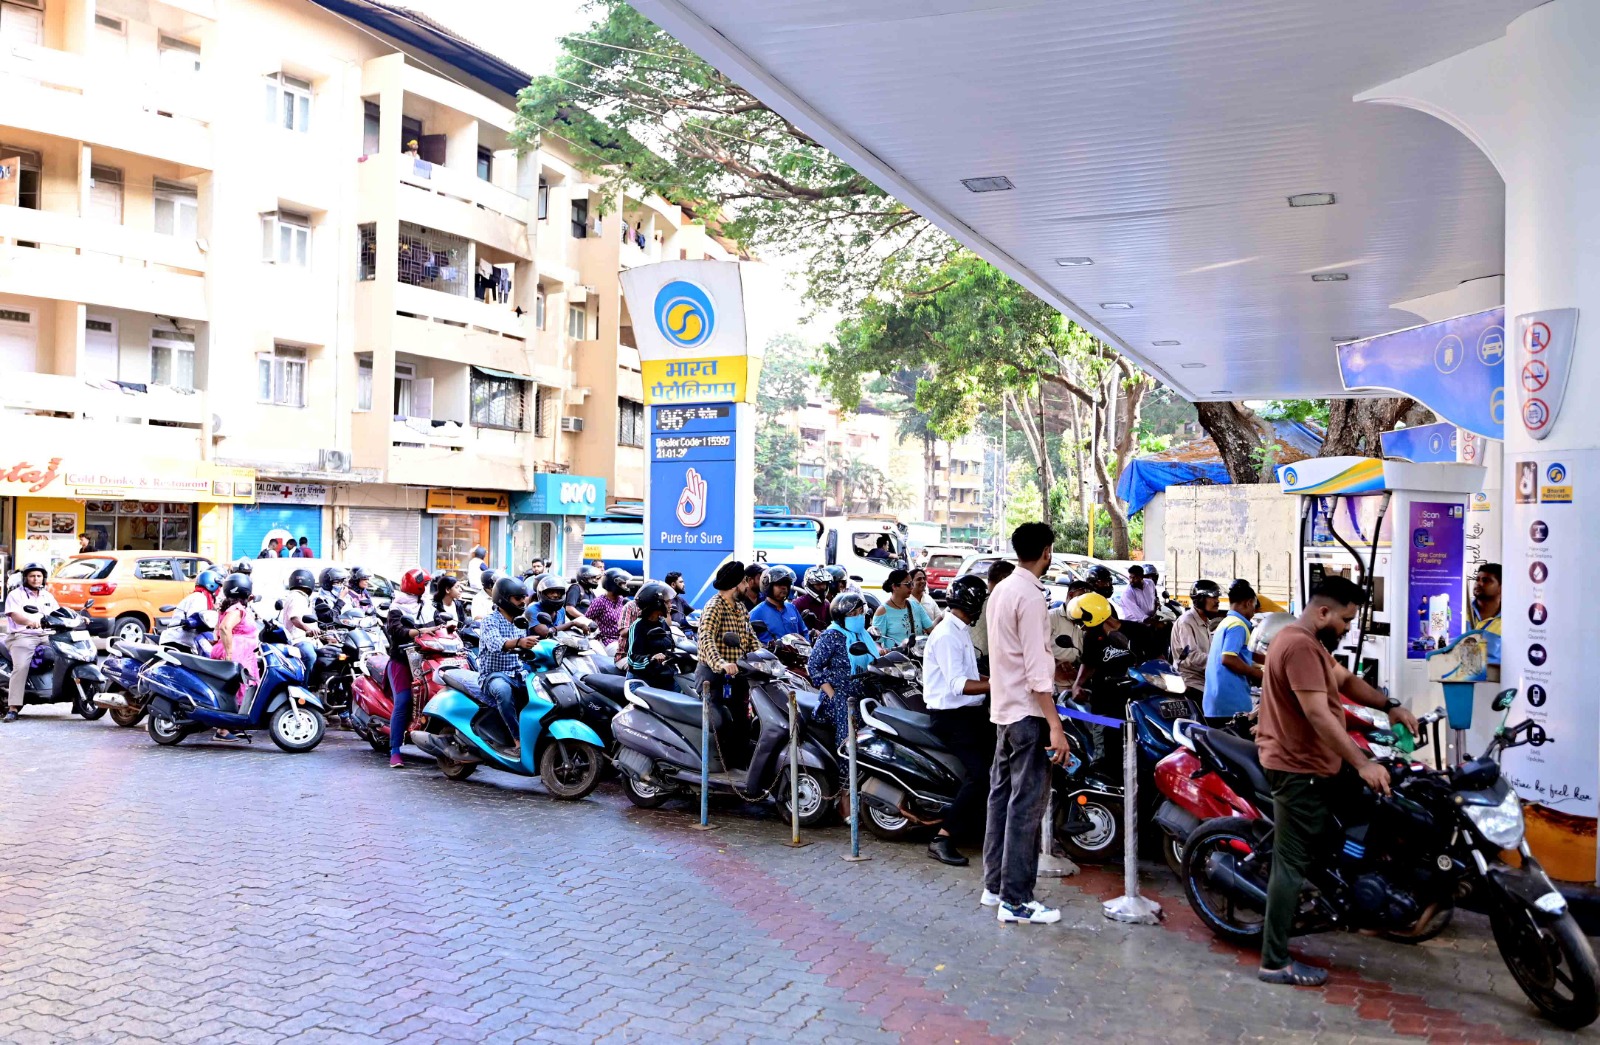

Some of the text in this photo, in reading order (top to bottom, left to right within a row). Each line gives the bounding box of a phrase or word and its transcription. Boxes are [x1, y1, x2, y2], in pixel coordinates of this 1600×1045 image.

[666, 360, 718, 377] भारत
[266, 484, 282, 492] CLINIC
[660, 531, 722, 544] Pure for Sure
[623, 728, 648, 739] Activa
[1549, 784, 1569, 798] feel
